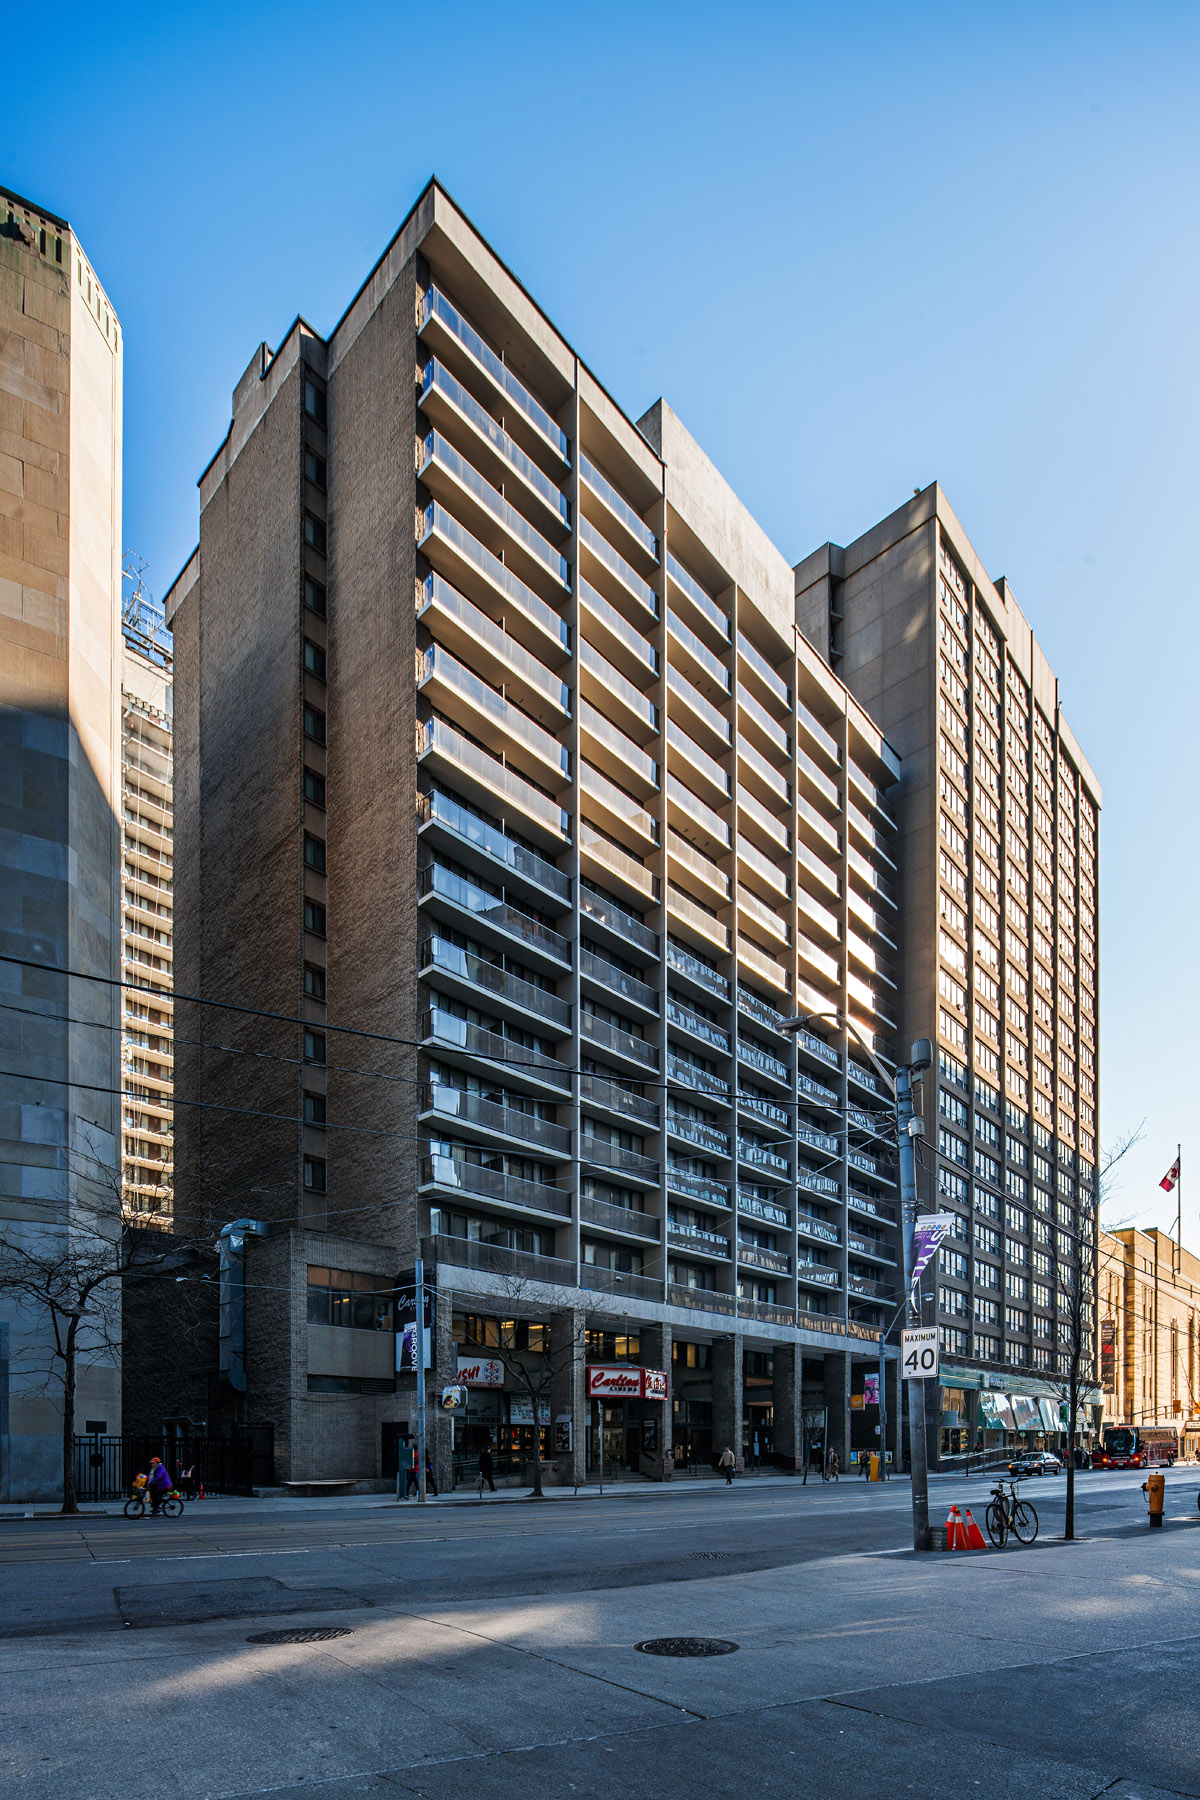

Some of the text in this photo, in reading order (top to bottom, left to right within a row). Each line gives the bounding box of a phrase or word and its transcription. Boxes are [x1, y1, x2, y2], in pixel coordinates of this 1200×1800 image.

[904, 1332, 936, 1343] MAXIMUM
[904, 1348, 935, 1371] 40
[591, 1371, 640, 1388] Carlton
